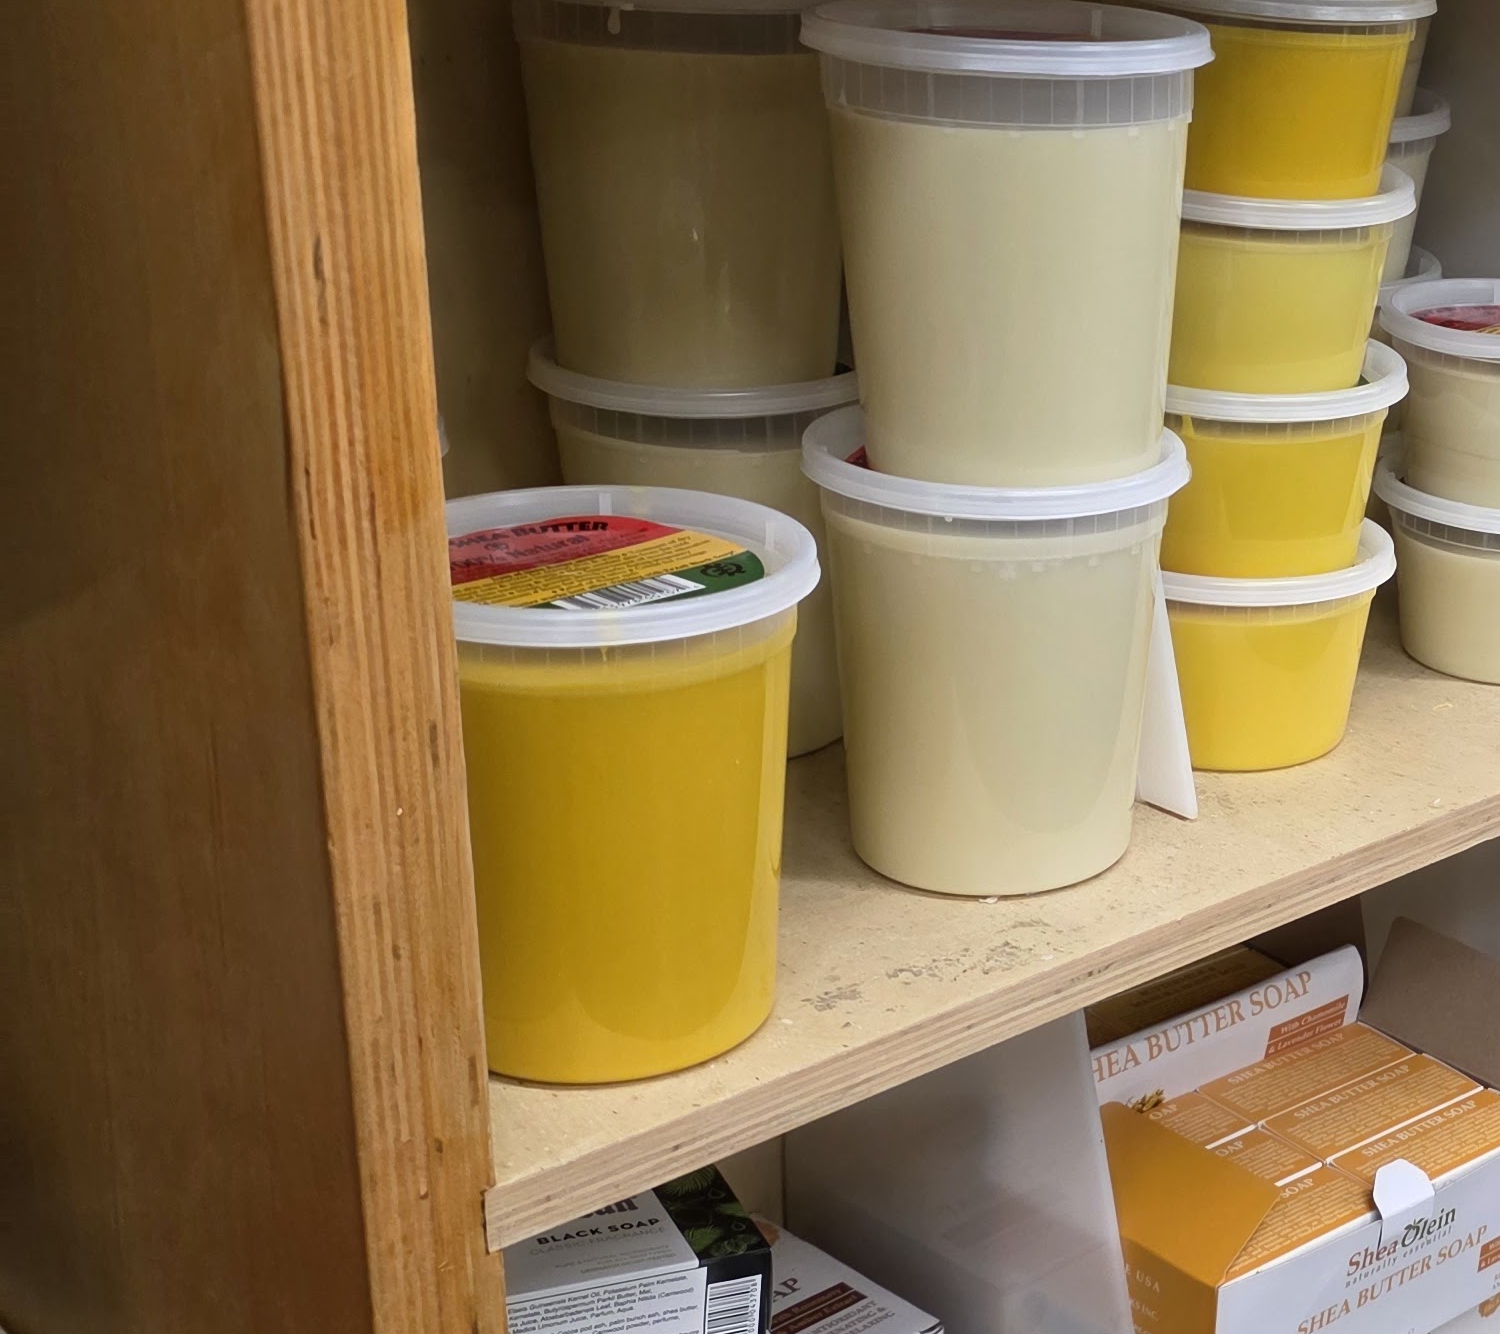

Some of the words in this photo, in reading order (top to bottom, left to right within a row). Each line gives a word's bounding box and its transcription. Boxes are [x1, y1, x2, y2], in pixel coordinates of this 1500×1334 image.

[516, 520, 609, 538] BUTTER
[1146, 999, 1246, 1063] BUTTER
[1250, 970, 1312, 1017] SOAP
[1293, 1099, 1328, 1120] SHEA
[1327, 1079, 1378, 1106] BUTTER
[1378, 1063, 1411, 1083] SOAP
[1361, 1134, 1399, 1158] SHEA
[1397, 1114, 1444, 1142] BUTTER
[1443, 1099, 1478, 1120] SOAP
[536, 1226, 602, 1246] BLACK
[607, 1217, 661, 1234] SOAP
[1355, 1255, 1433, 1309] BUTTER
[1435, 1223, 1488, 1267] SOAP
